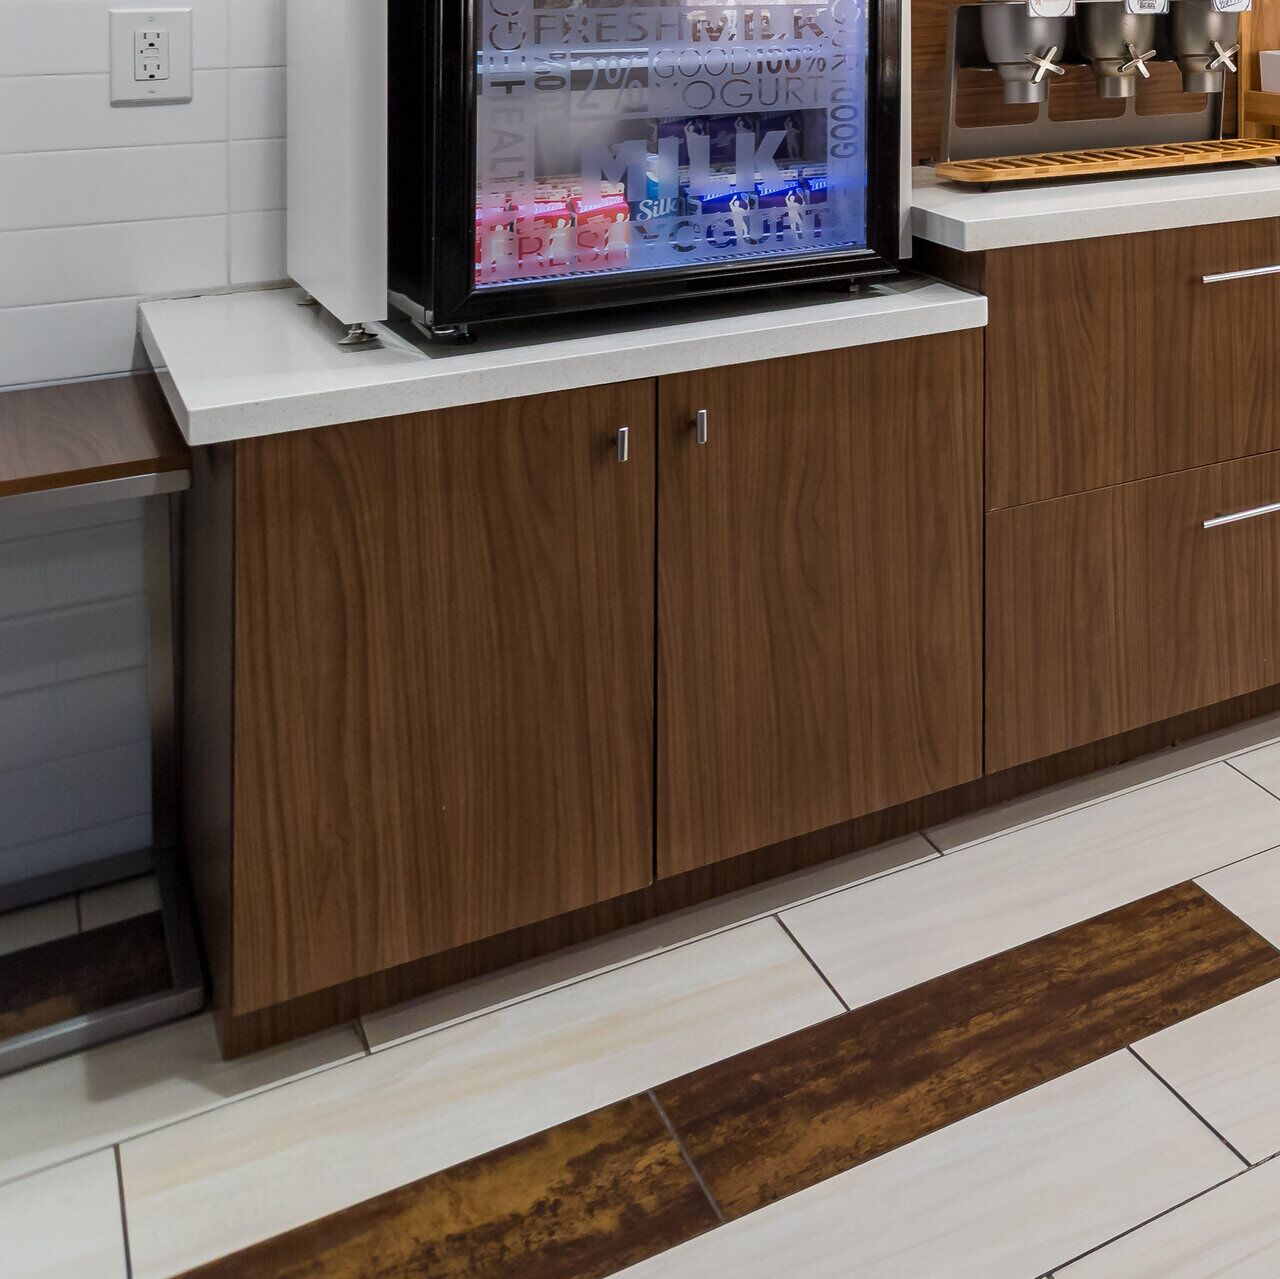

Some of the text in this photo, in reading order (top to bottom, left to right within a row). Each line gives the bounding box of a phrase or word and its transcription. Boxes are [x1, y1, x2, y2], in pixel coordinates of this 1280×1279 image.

[534, 7, 826, 44] FRESH MILK
[653, 44, 827, 79] GOOD 100%
[655, 76, 824, 110] YOGURT
[829, 86, 858, 159] GOOD
[581, 128, 789, 202] MILK
[636, 197, 679, 222] Silk
